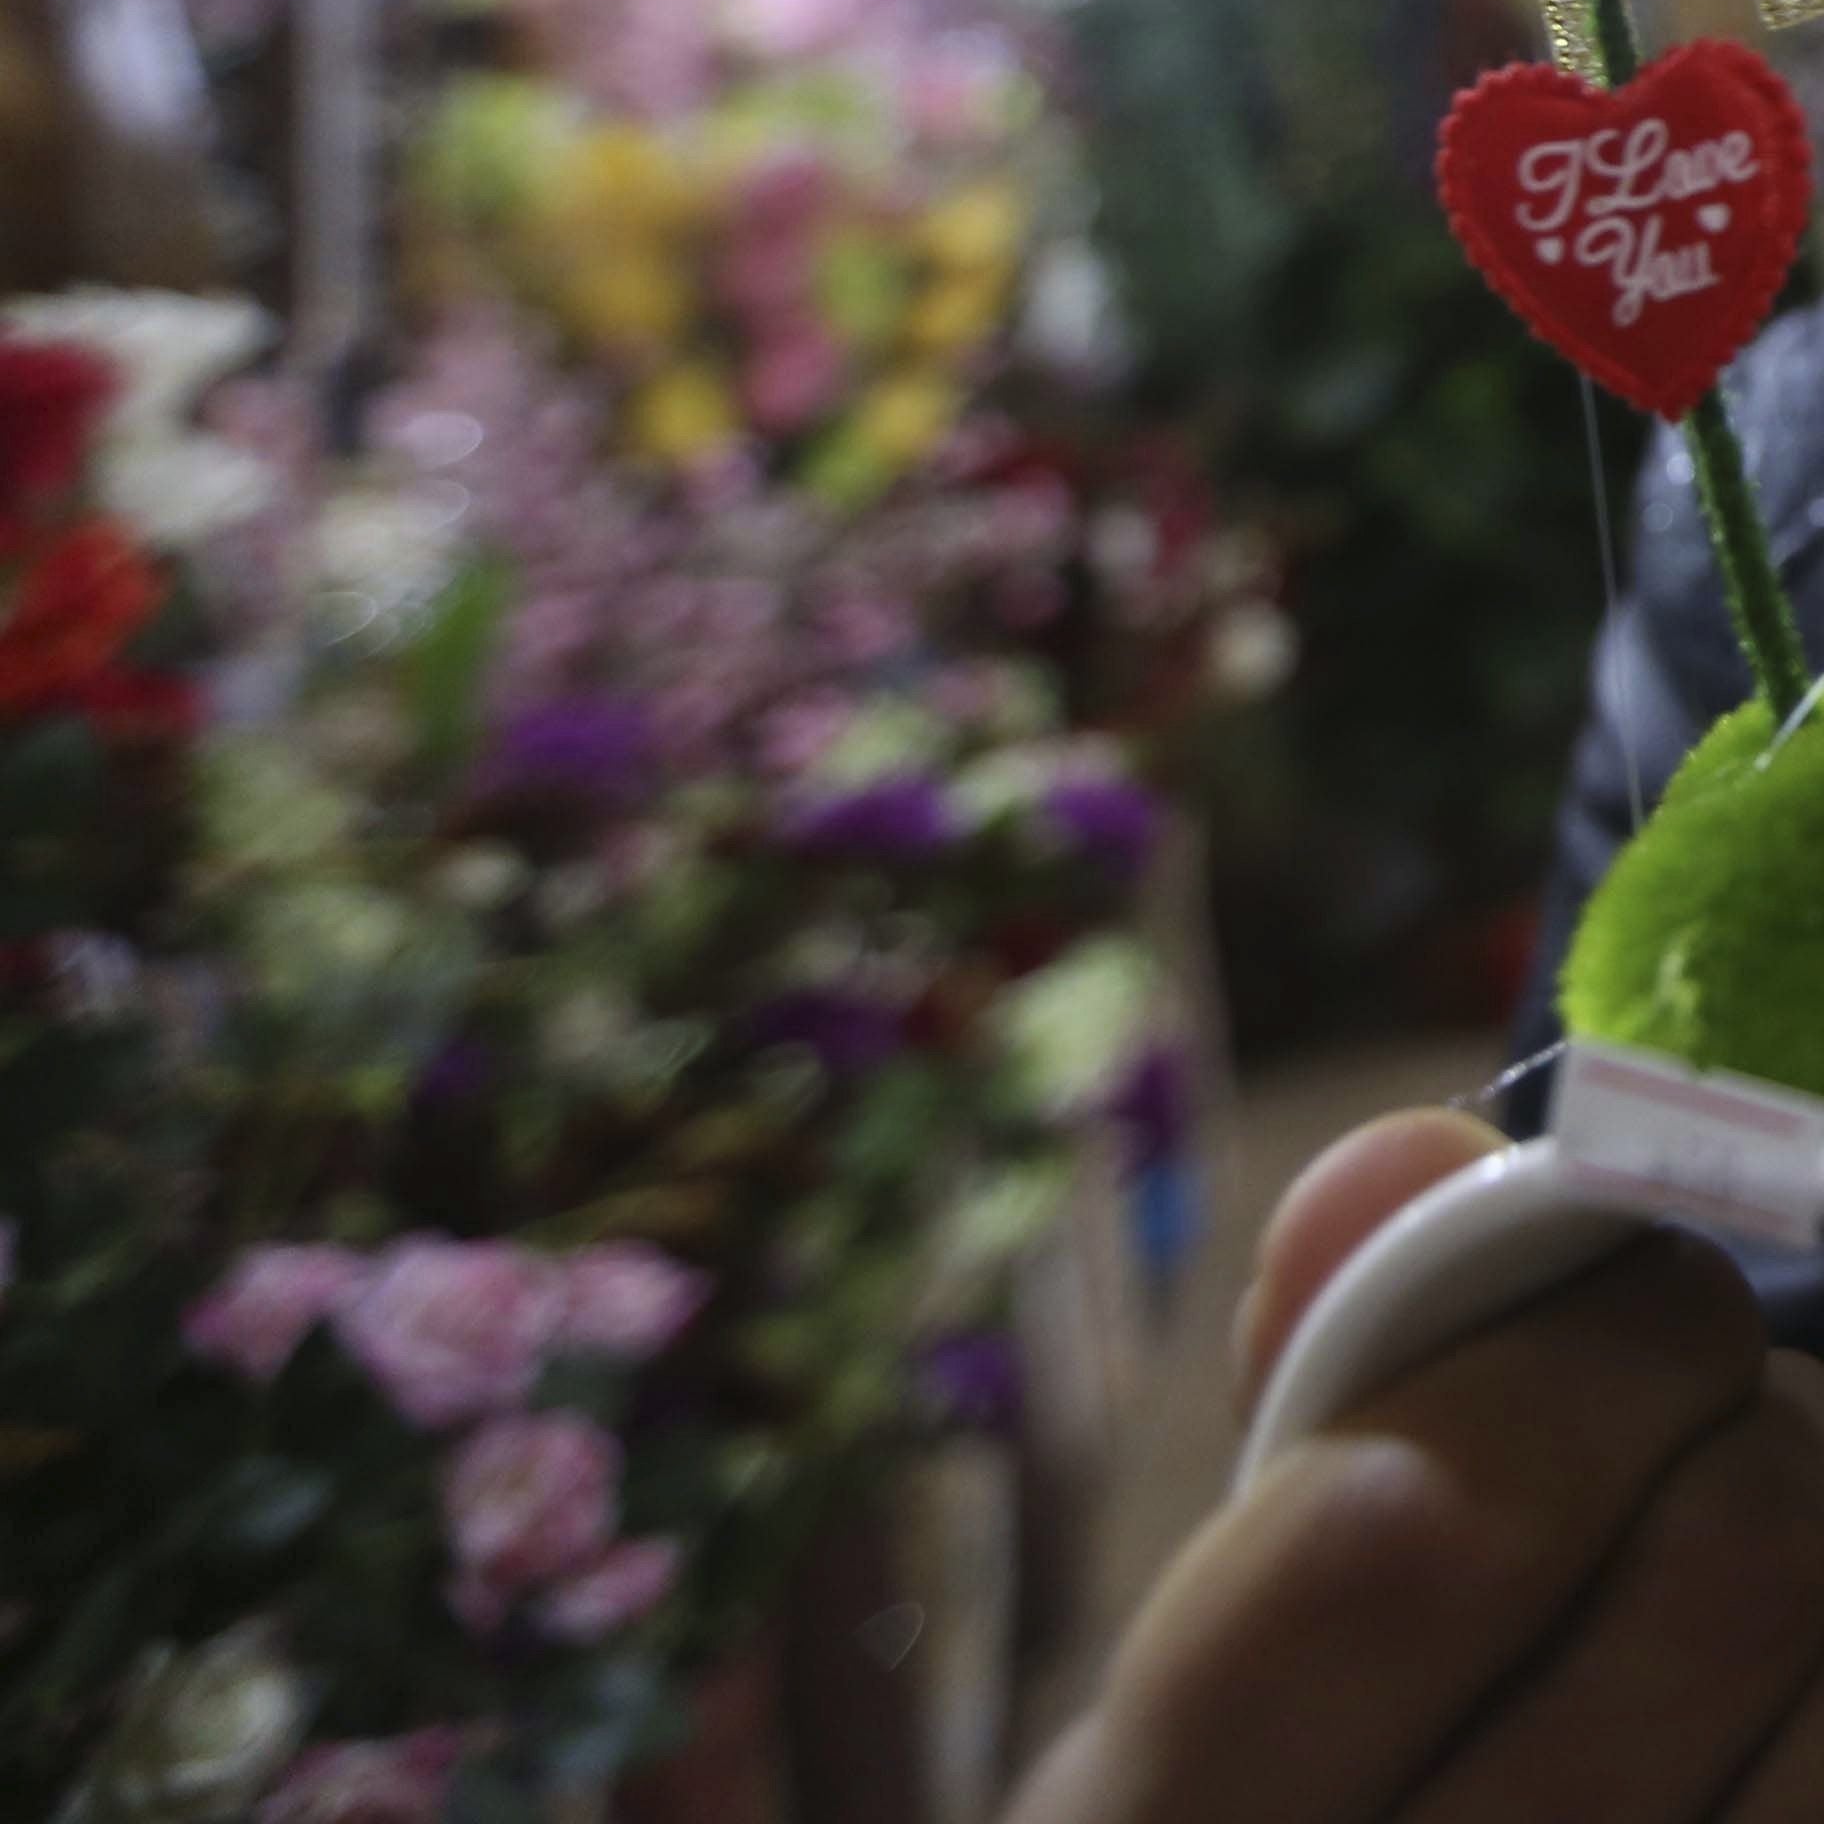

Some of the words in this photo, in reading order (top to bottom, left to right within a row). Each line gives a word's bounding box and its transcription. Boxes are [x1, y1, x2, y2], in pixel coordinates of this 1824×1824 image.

[1517, 140, 1580, 230] I
[1582, 118, 1761, 216] Love
[1573, 212, 1721, 327] You
